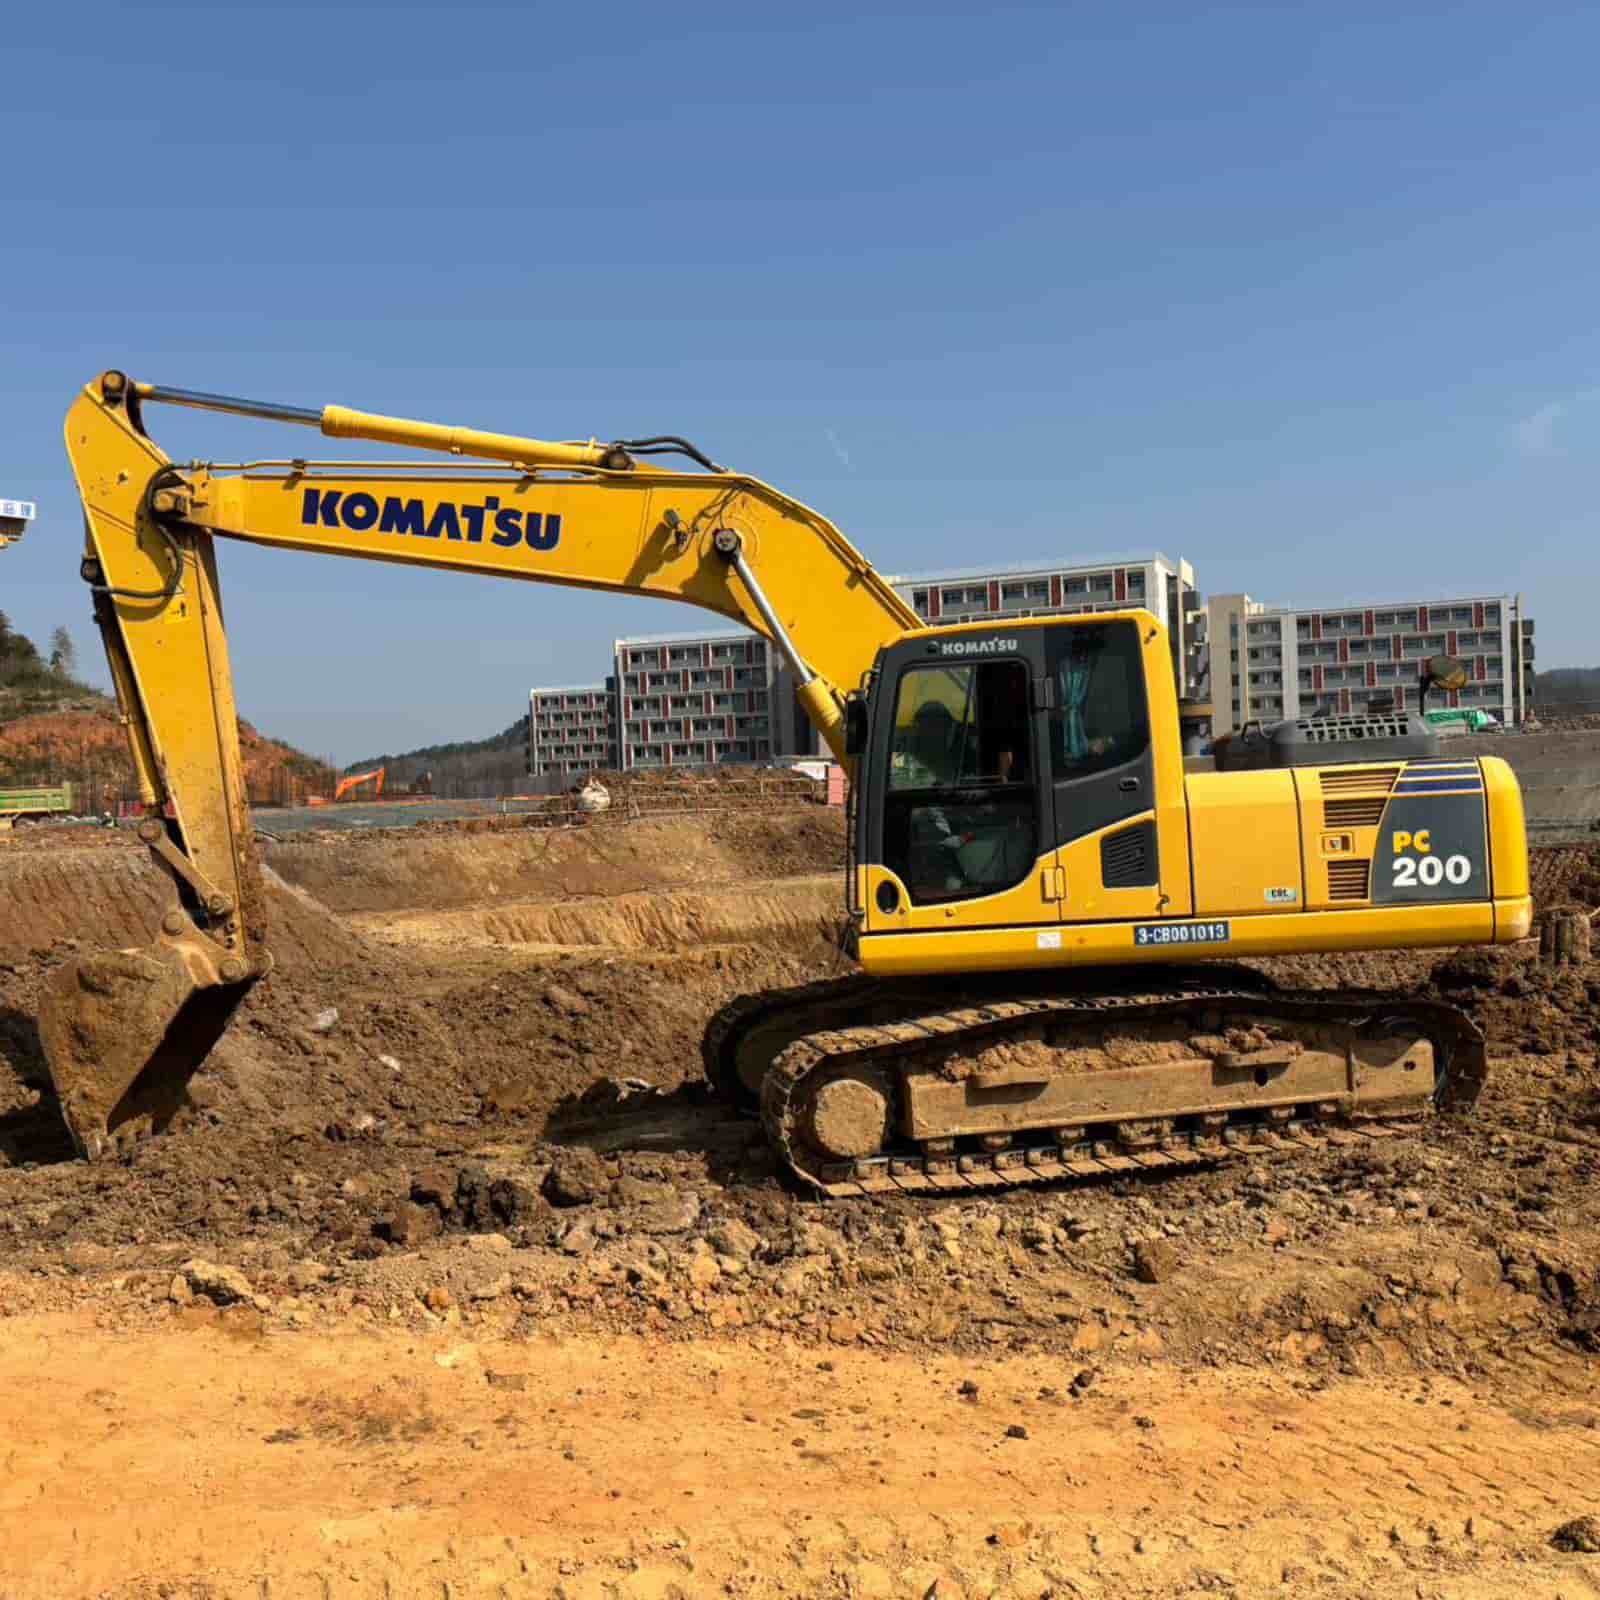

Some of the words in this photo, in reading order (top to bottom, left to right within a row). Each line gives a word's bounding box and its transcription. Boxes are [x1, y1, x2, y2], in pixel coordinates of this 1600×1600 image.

[302, 488, 561, 550] KOMATSU
[942, 637, 1017, 655] KOMATSU
[1393, 830, 1431, 854] PC
[1392, 854, 1471, 887] 200
